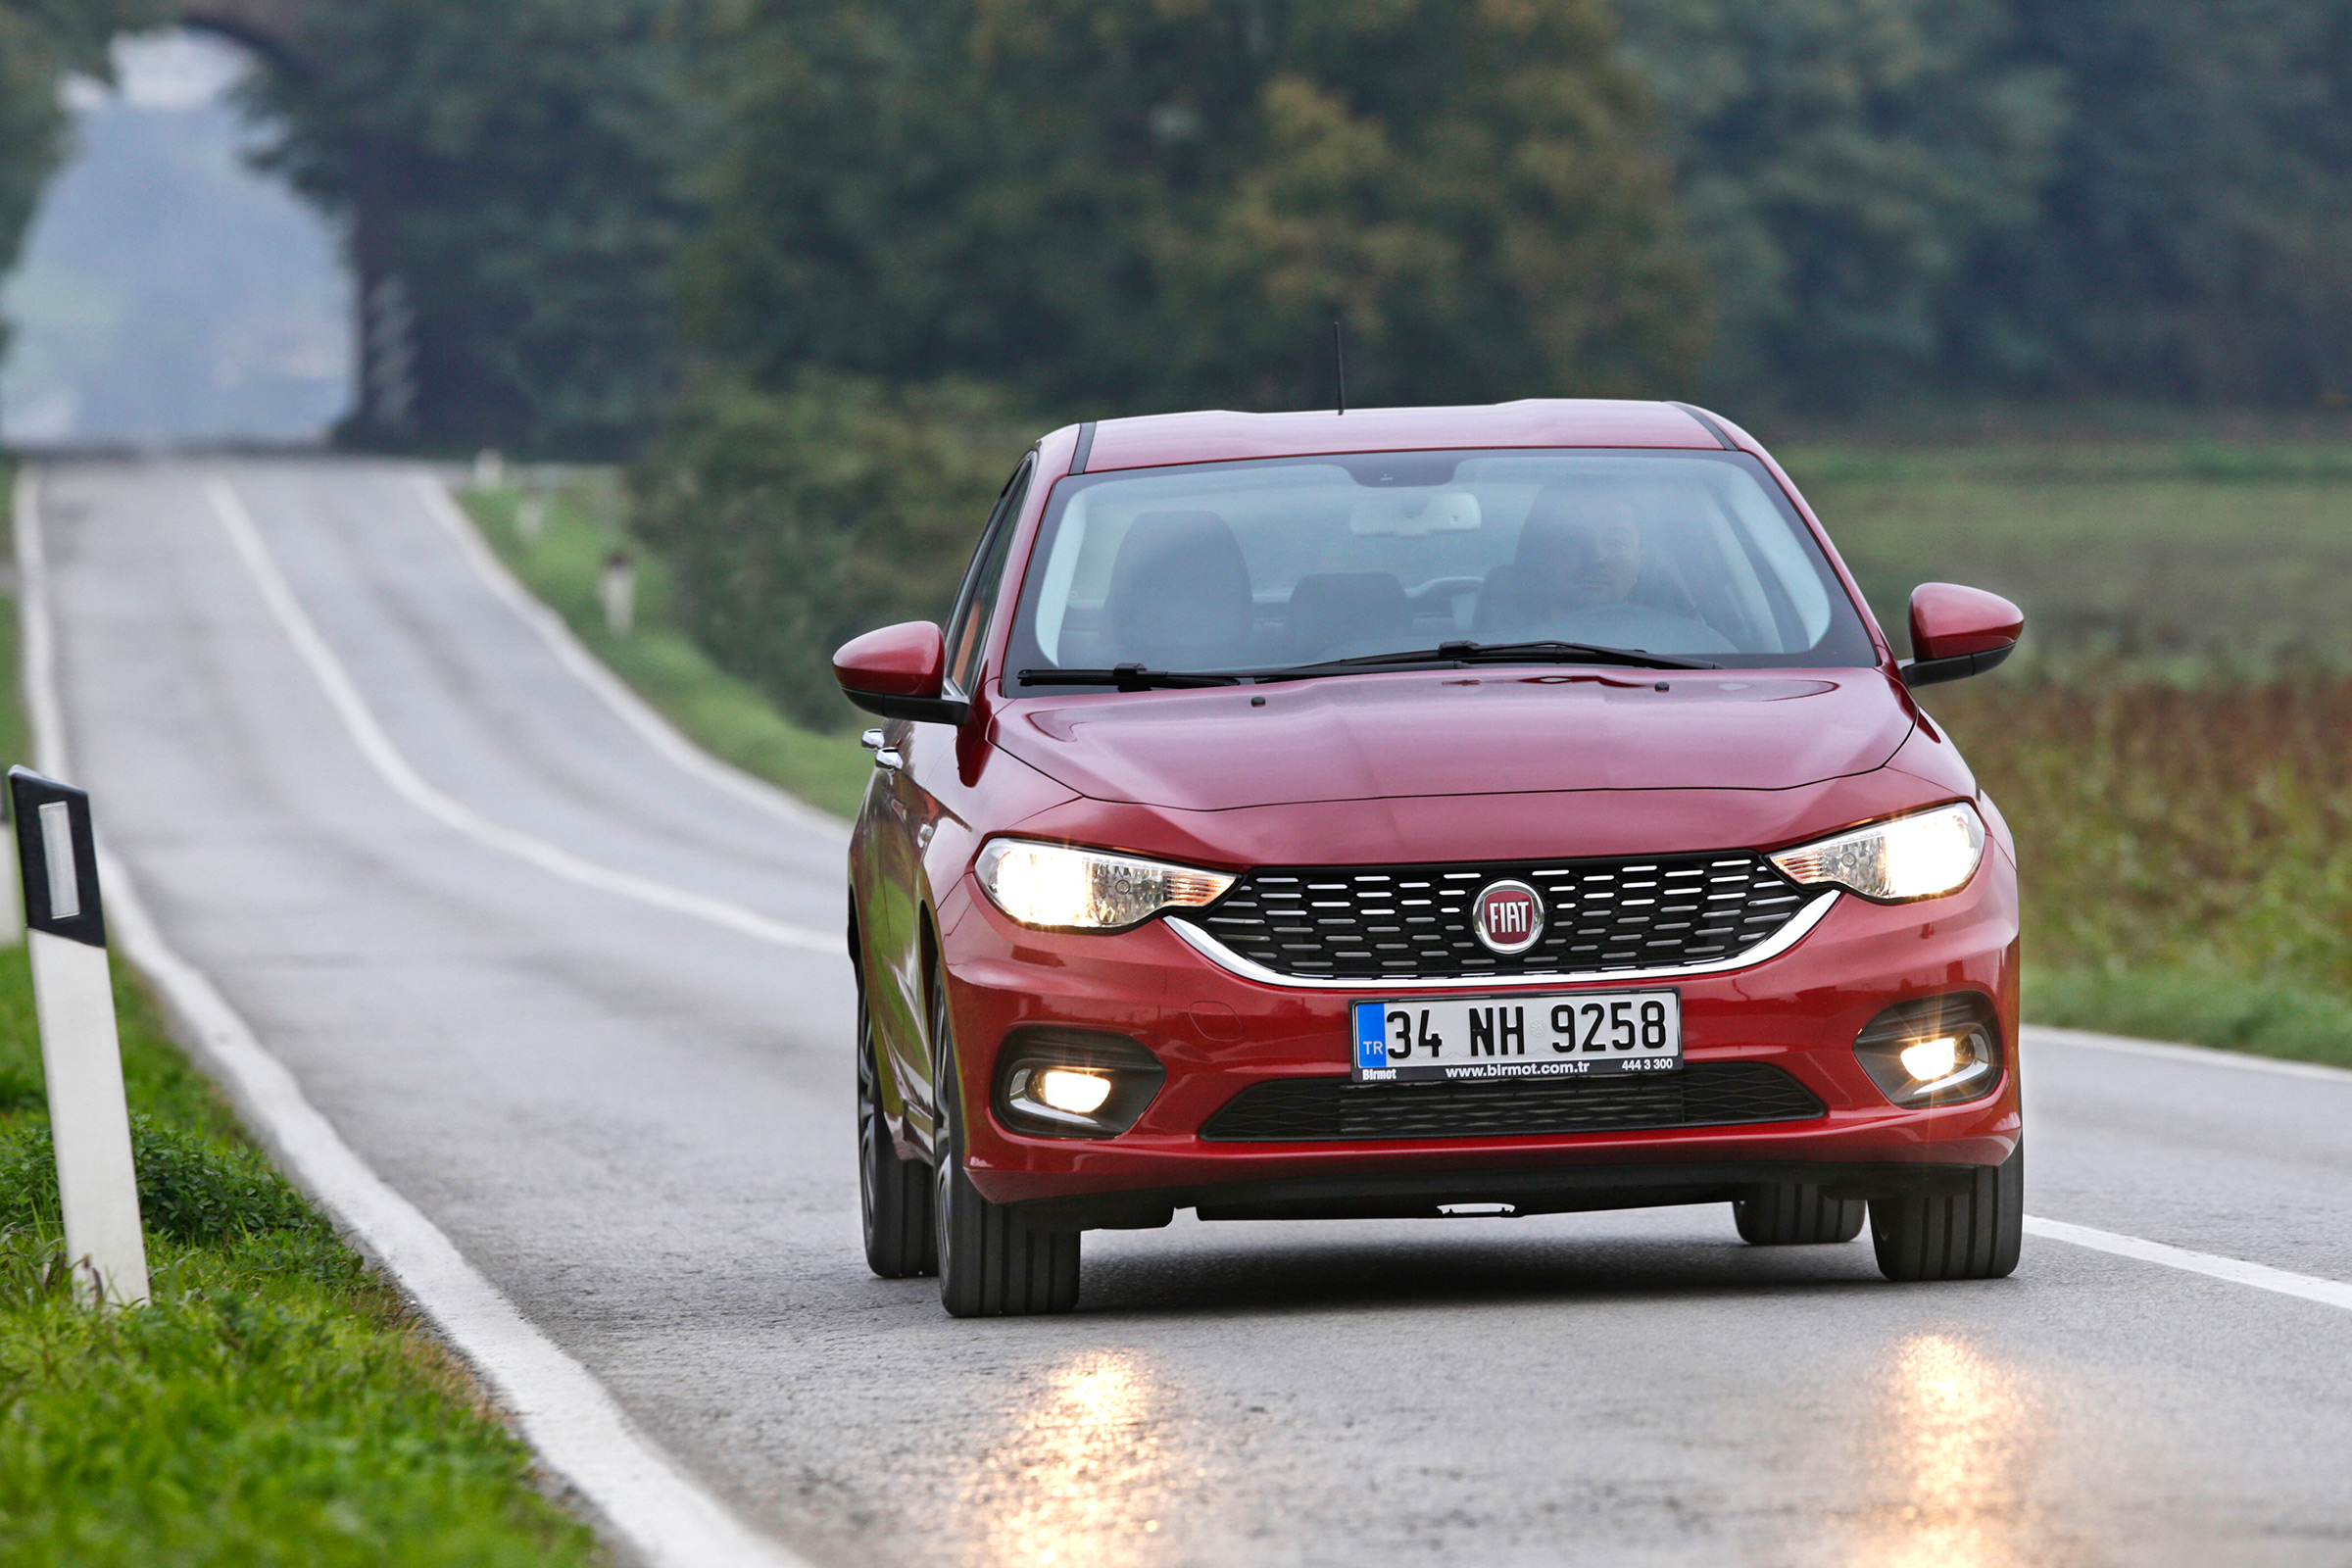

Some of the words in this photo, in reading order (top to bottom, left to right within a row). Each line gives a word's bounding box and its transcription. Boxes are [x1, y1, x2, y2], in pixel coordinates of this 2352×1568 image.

[1490, 902, 1529, 933] FIAT
[1387, 1009, 1443, 1059] 34
[1468, 1006, 1525, 1056] NH
[1551, 1001, 1666, 1054] 9258
[1362, 1041, 1384, 1055] TR
[1446, 1061, 1590, 1078] www.birmot.com.tr
[1622, 1060, 1642, 1070] 444
[1643, 1059, 1651, 1070] 3
[1653, 1058, 1673, 1069] 300
[1362, 1068, 1396, 1080] Birmot
